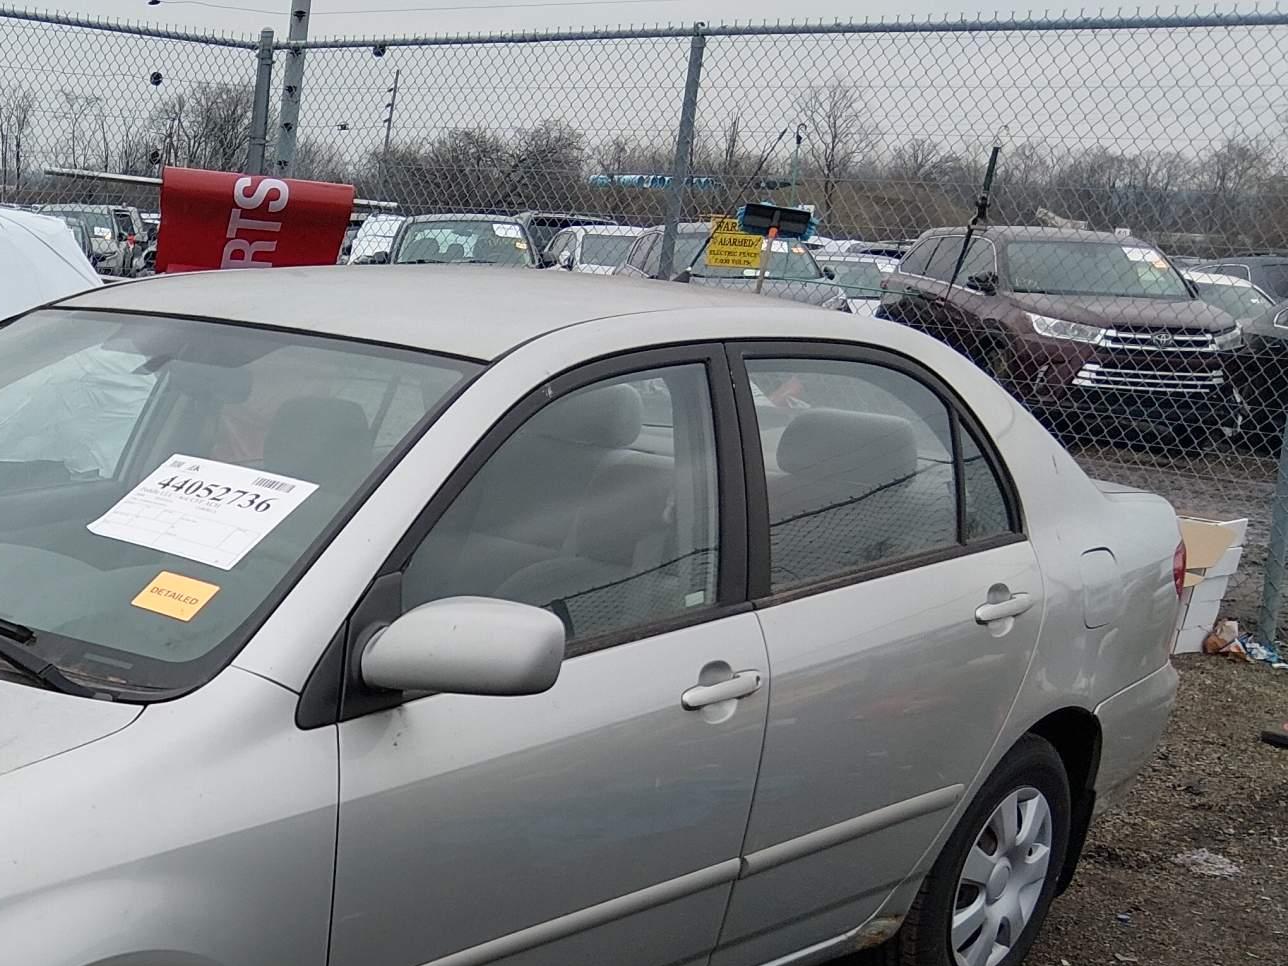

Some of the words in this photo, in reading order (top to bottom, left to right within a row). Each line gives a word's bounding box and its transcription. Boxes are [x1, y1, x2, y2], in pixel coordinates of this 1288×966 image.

[715, 221, 739, 231] WAR
[157, 475, 278, 514] 44052736
[149, 586, 199, 606] DETAILED
